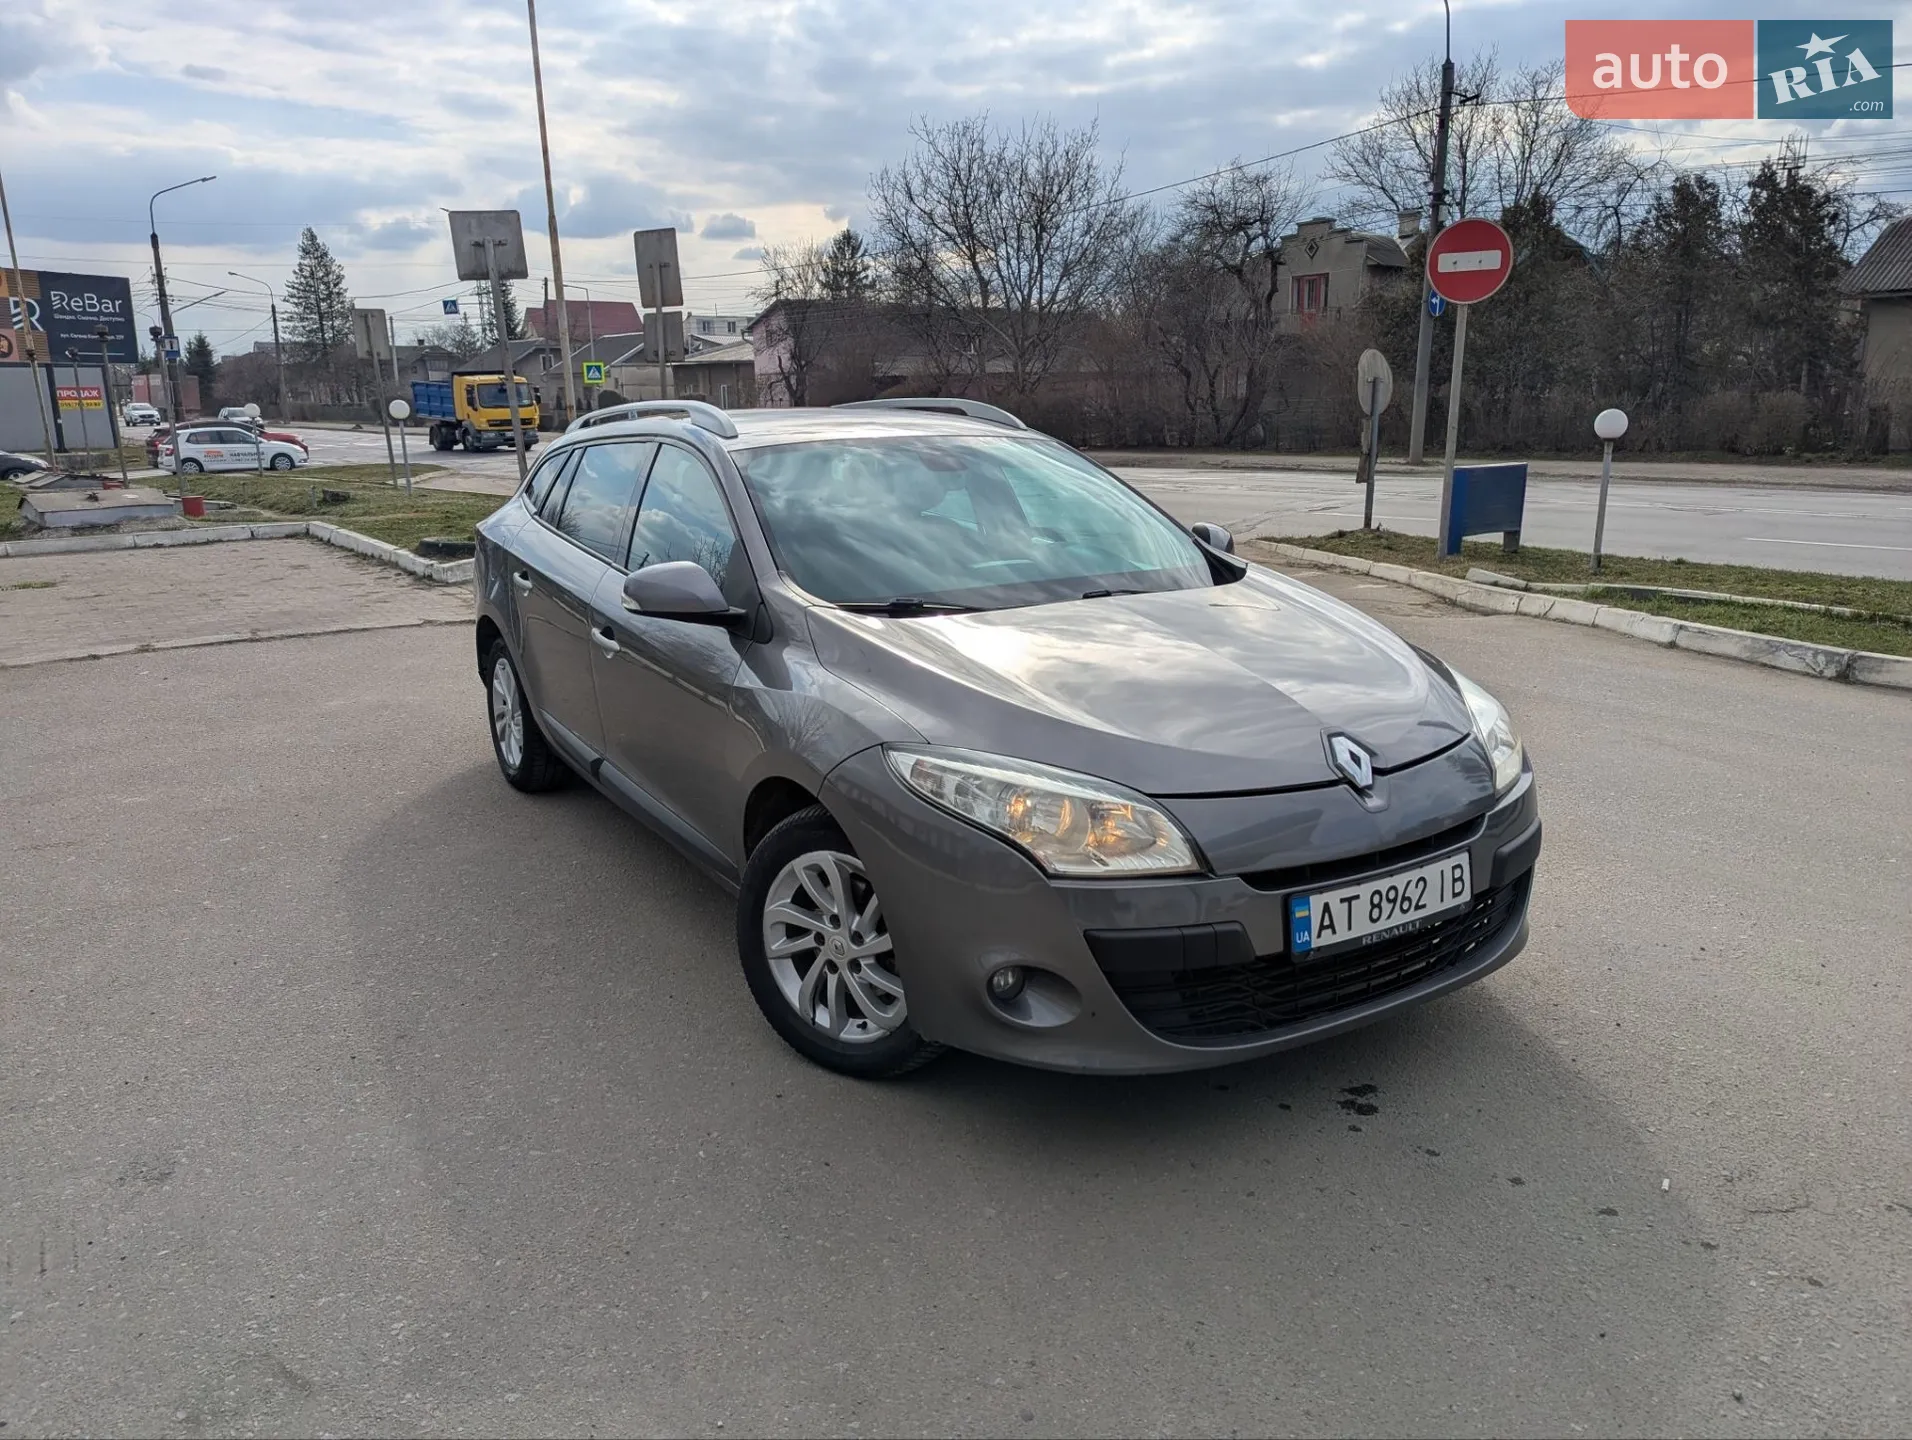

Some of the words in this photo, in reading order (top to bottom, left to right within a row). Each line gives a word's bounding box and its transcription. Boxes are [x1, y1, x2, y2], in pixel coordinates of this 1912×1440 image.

[50, 291, 122, 313] ReBar
[1316, 894, 1360, 939] AT
[1368, 876, 1427, 924] 8962
[1440, 863, 1465, 903] IB
[1296, 931, 1310, 944] UA
[1362, 920, 1421, 945] RENAULT
